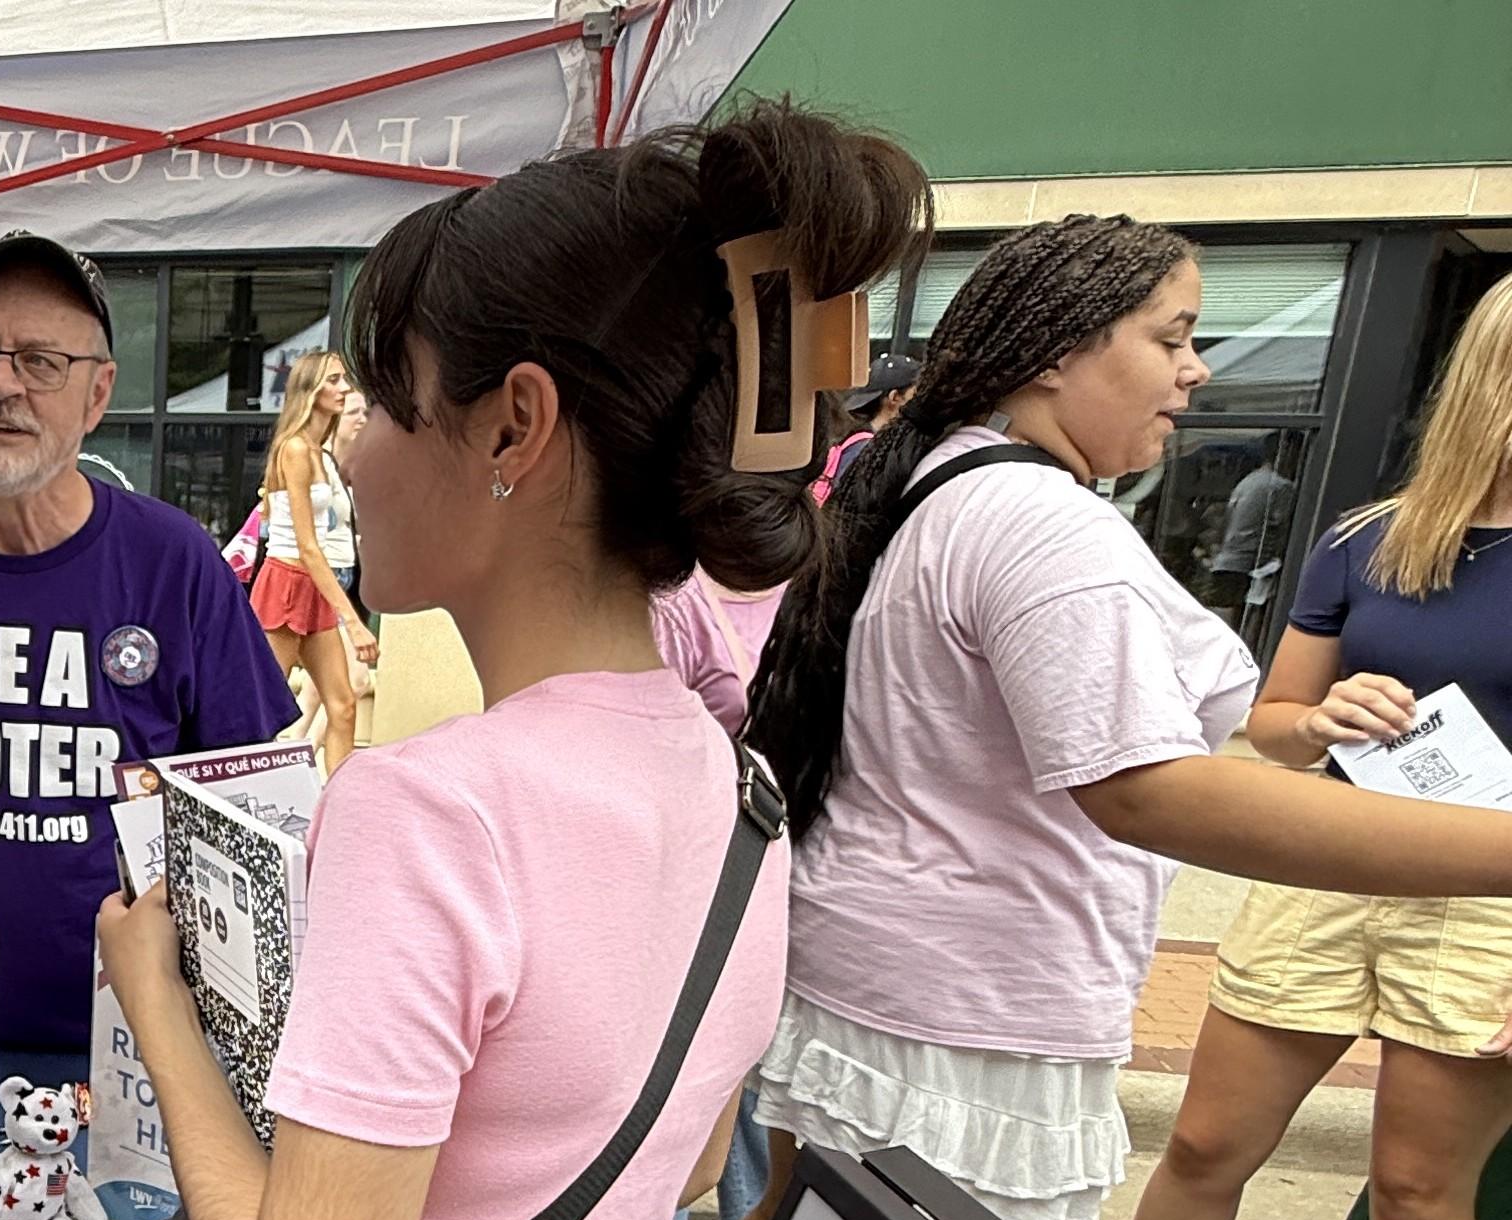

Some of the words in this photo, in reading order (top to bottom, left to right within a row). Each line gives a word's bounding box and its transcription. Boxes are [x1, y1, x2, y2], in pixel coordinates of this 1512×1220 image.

[40, 630, 88, 709] A
[251, 757, 271, 770] NO
[272, 751, 311, 767] HACER
[117, 1070, 155, 1108] TO
